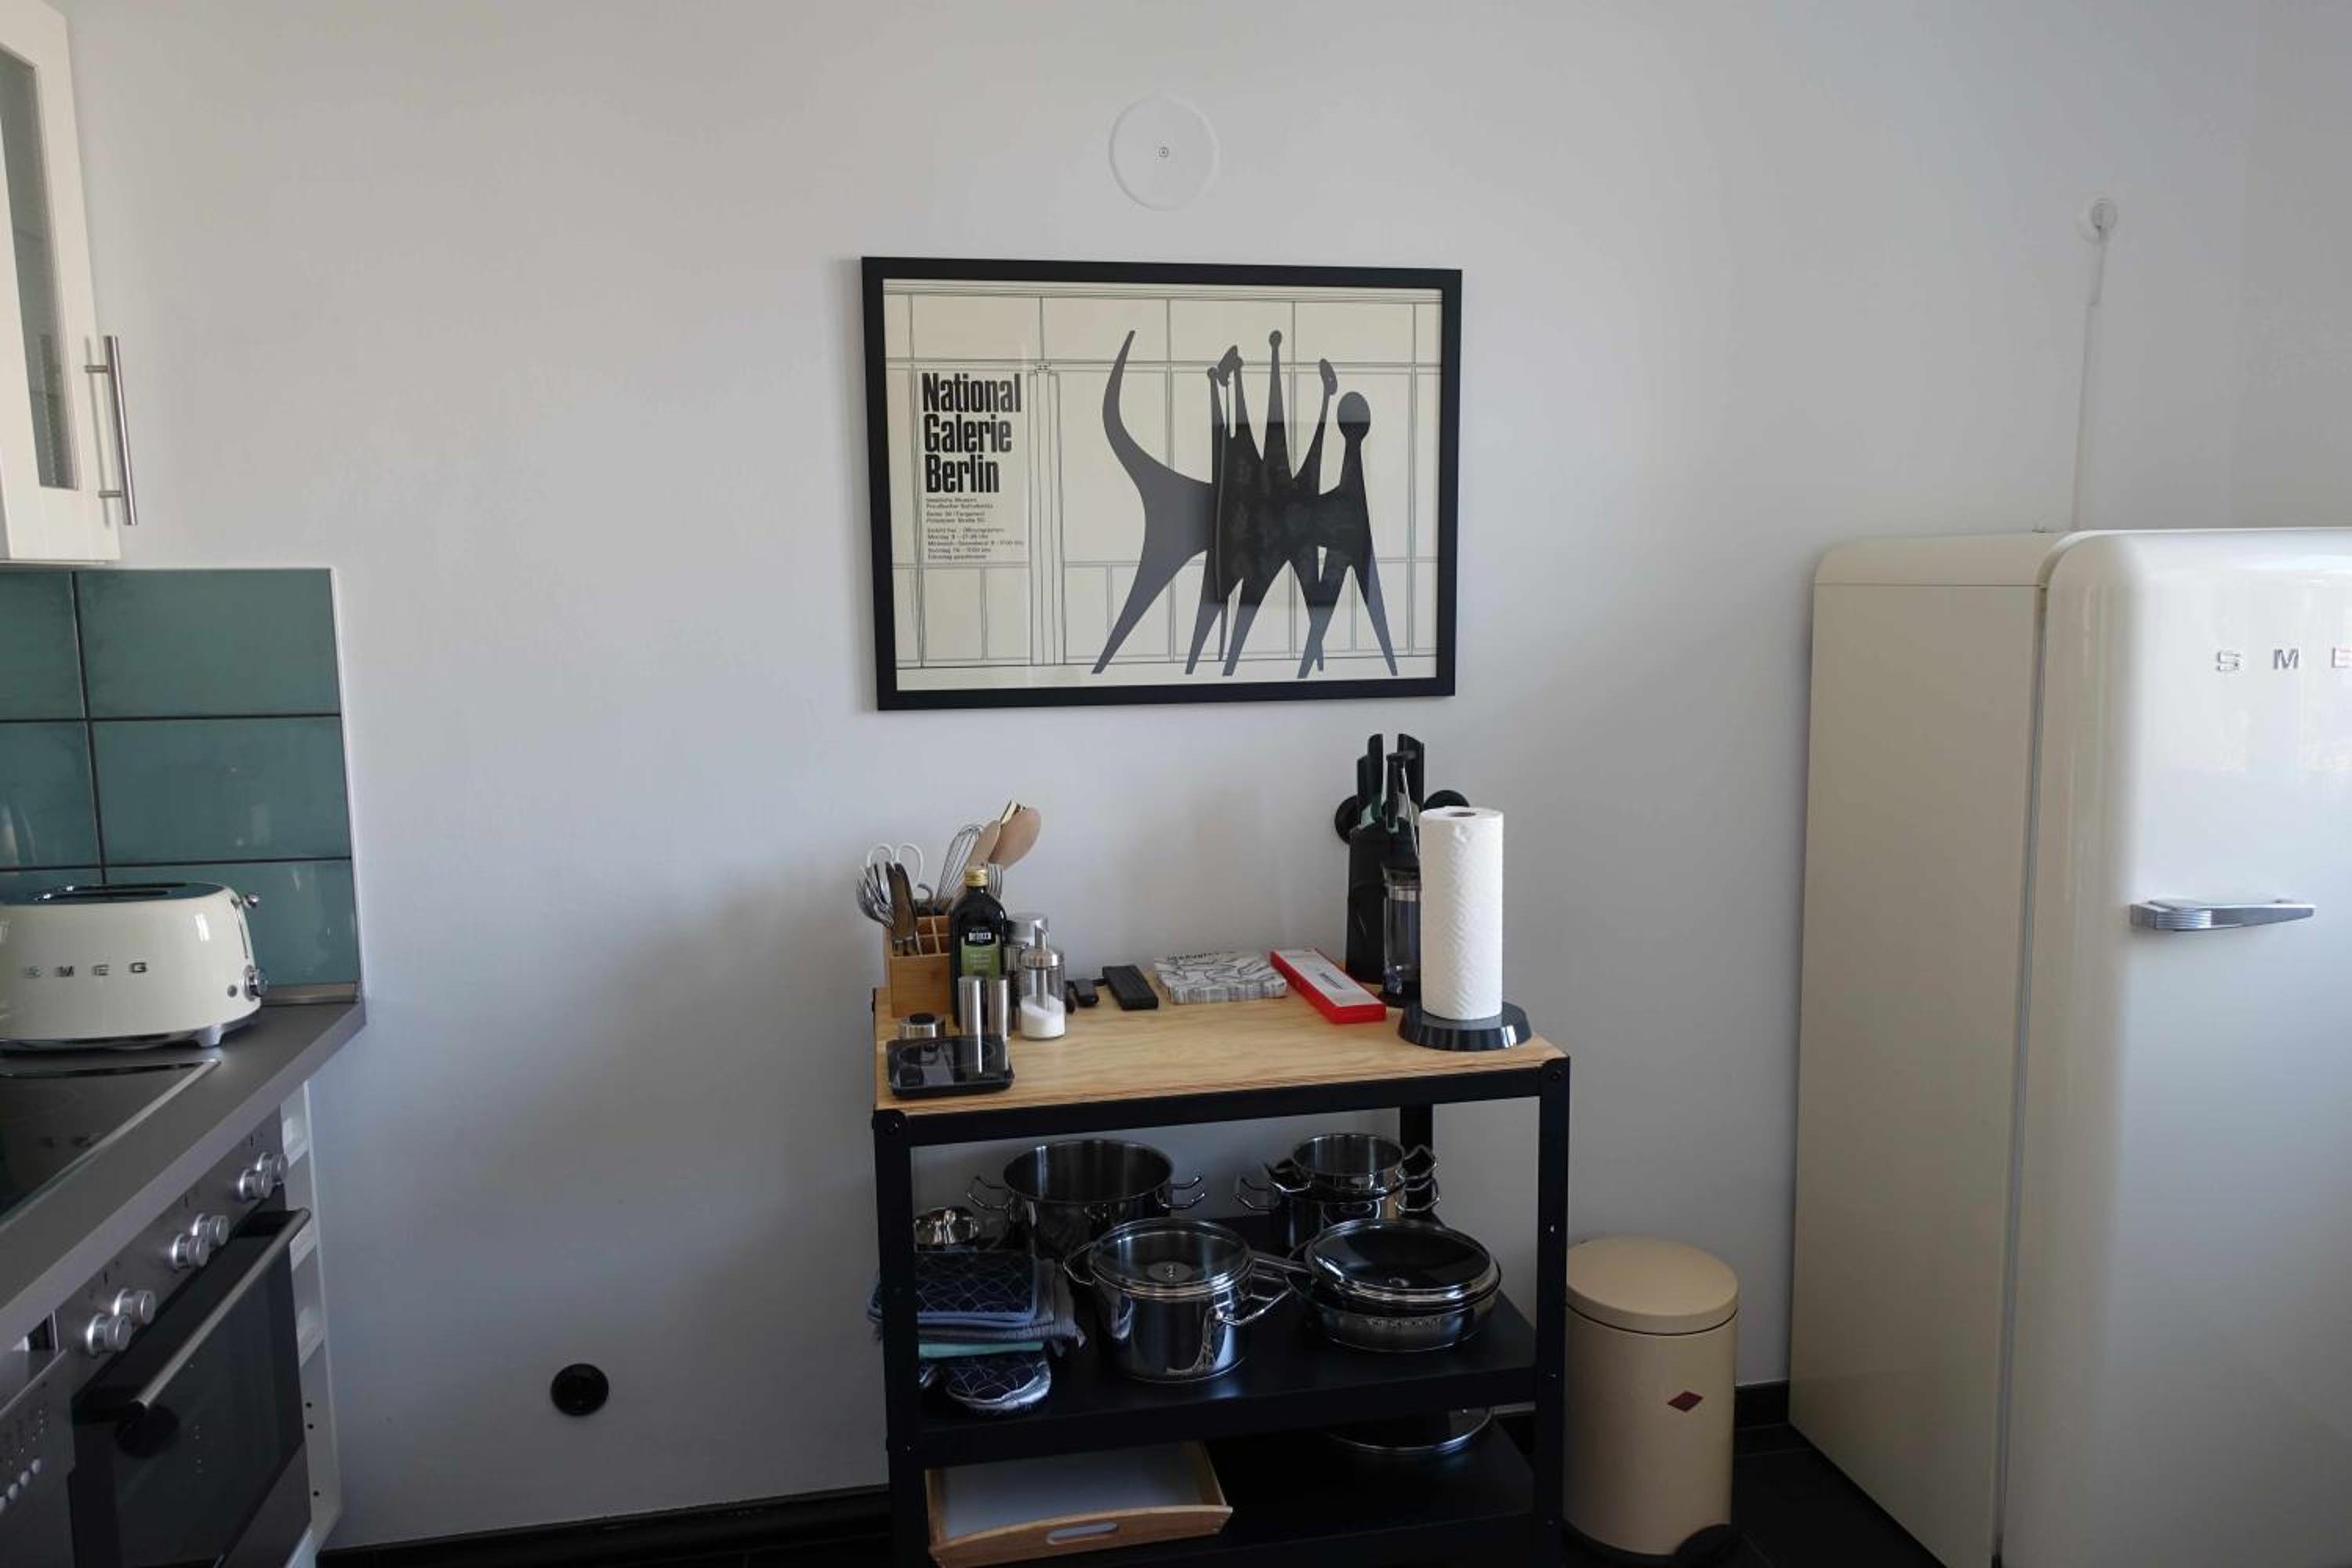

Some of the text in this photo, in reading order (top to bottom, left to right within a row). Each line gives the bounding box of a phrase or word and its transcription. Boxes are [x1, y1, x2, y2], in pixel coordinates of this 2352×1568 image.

[922, 372, 1021, 412] National
[924, 414, 1011, 452] Galerie
[925, 454, 1000, 493] Berlin
[23, 961, 147, 979] SMEG
